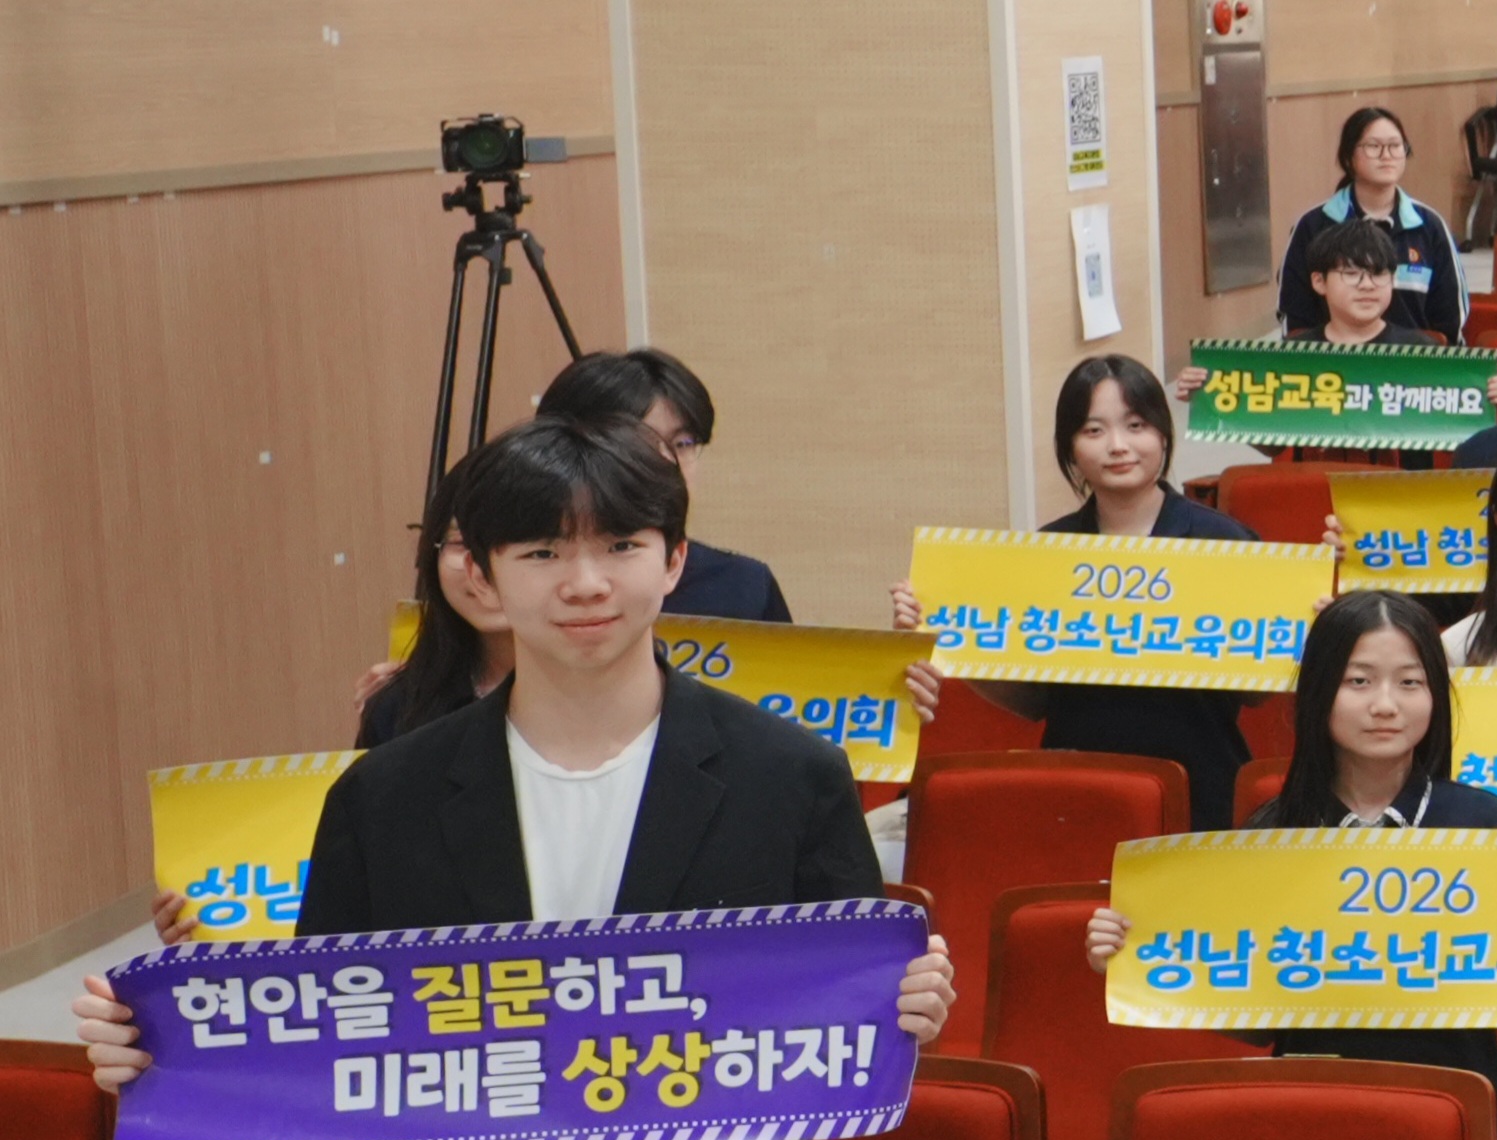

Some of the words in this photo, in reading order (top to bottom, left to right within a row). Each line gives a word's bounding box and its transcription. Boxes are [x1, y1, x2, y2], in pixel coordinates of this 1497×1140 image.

[1204, 369, 1373, 415] 성남교육과
[1377, 382, 1484, 416] 함께해요
[1353, 528, 1430, 568] 성남
[1071, 563, 1173, 601] 2026
[656, 638, 733, 678] 26
[925, 605, 1011, 650] 성남
[1018, 605, 1307, 663] 청소년교육의회
[185, 858, 313, 928] 성남
[1337, 866, 1479, 914] 2026
[1135, 928, 1257, 990] 성남
[172, 964, 394, 1048] 현안을
[411, 952, 708, 1035] 질문하고,
[333, 1038, 547, 1118] 미래를
[561, 1023, 874, 1114] 상상하자!
